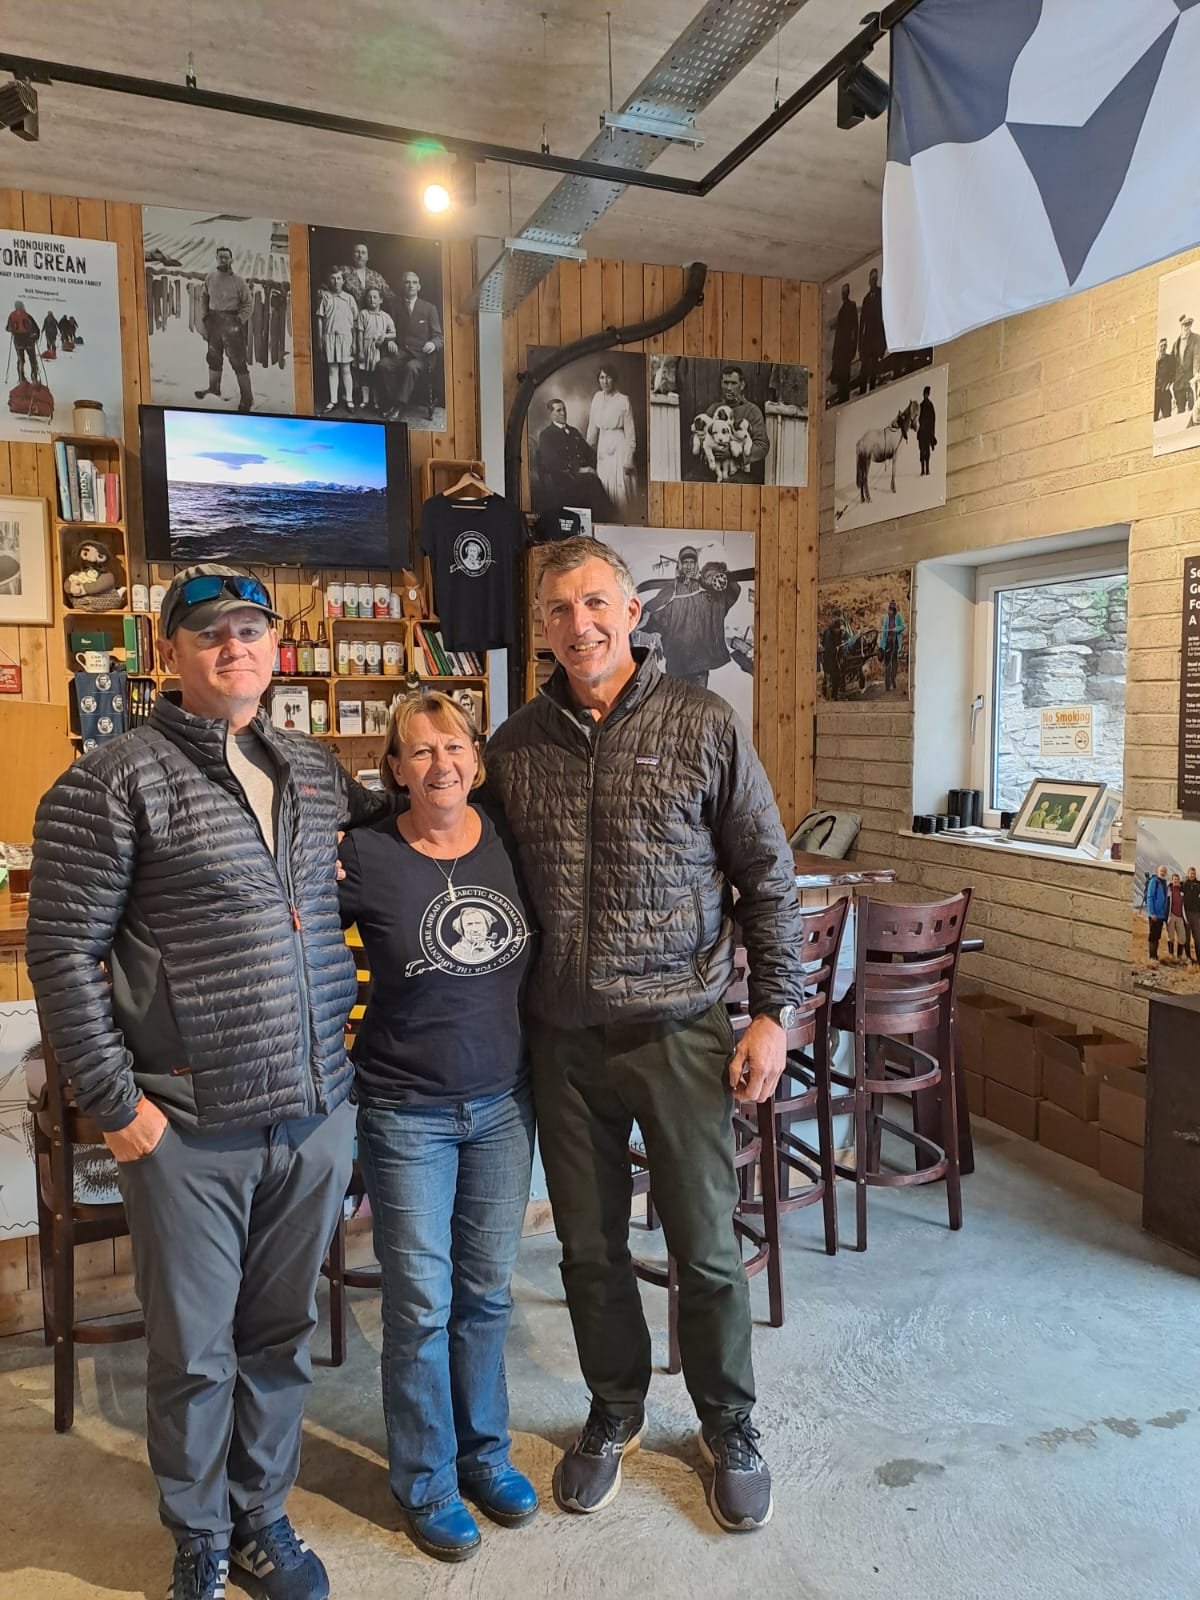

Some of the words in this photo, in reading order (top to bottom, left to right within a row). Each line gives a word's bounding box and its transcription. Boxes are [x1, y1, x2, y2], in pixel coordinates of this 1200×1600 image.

[13, 238, 65, 254] HONOURING
[33, 251, 86, 275] CREAN
[13, 272, 42, 281] EXPEDITION
[57, 276, 67, 284] THE
[67, 278, 84, 286] CREAN
[84, 280, 102, 288] FAMILY
[1188, 614, 1198, 626] A
[1055, 709, 1090, 725] Smoking
[426, 903, 441, 928] AHEAD
[424, 930, 456, 969] ADVENTURE
[455, 965, 472, 974] THE
[474, 964, 491, 973] FOR
